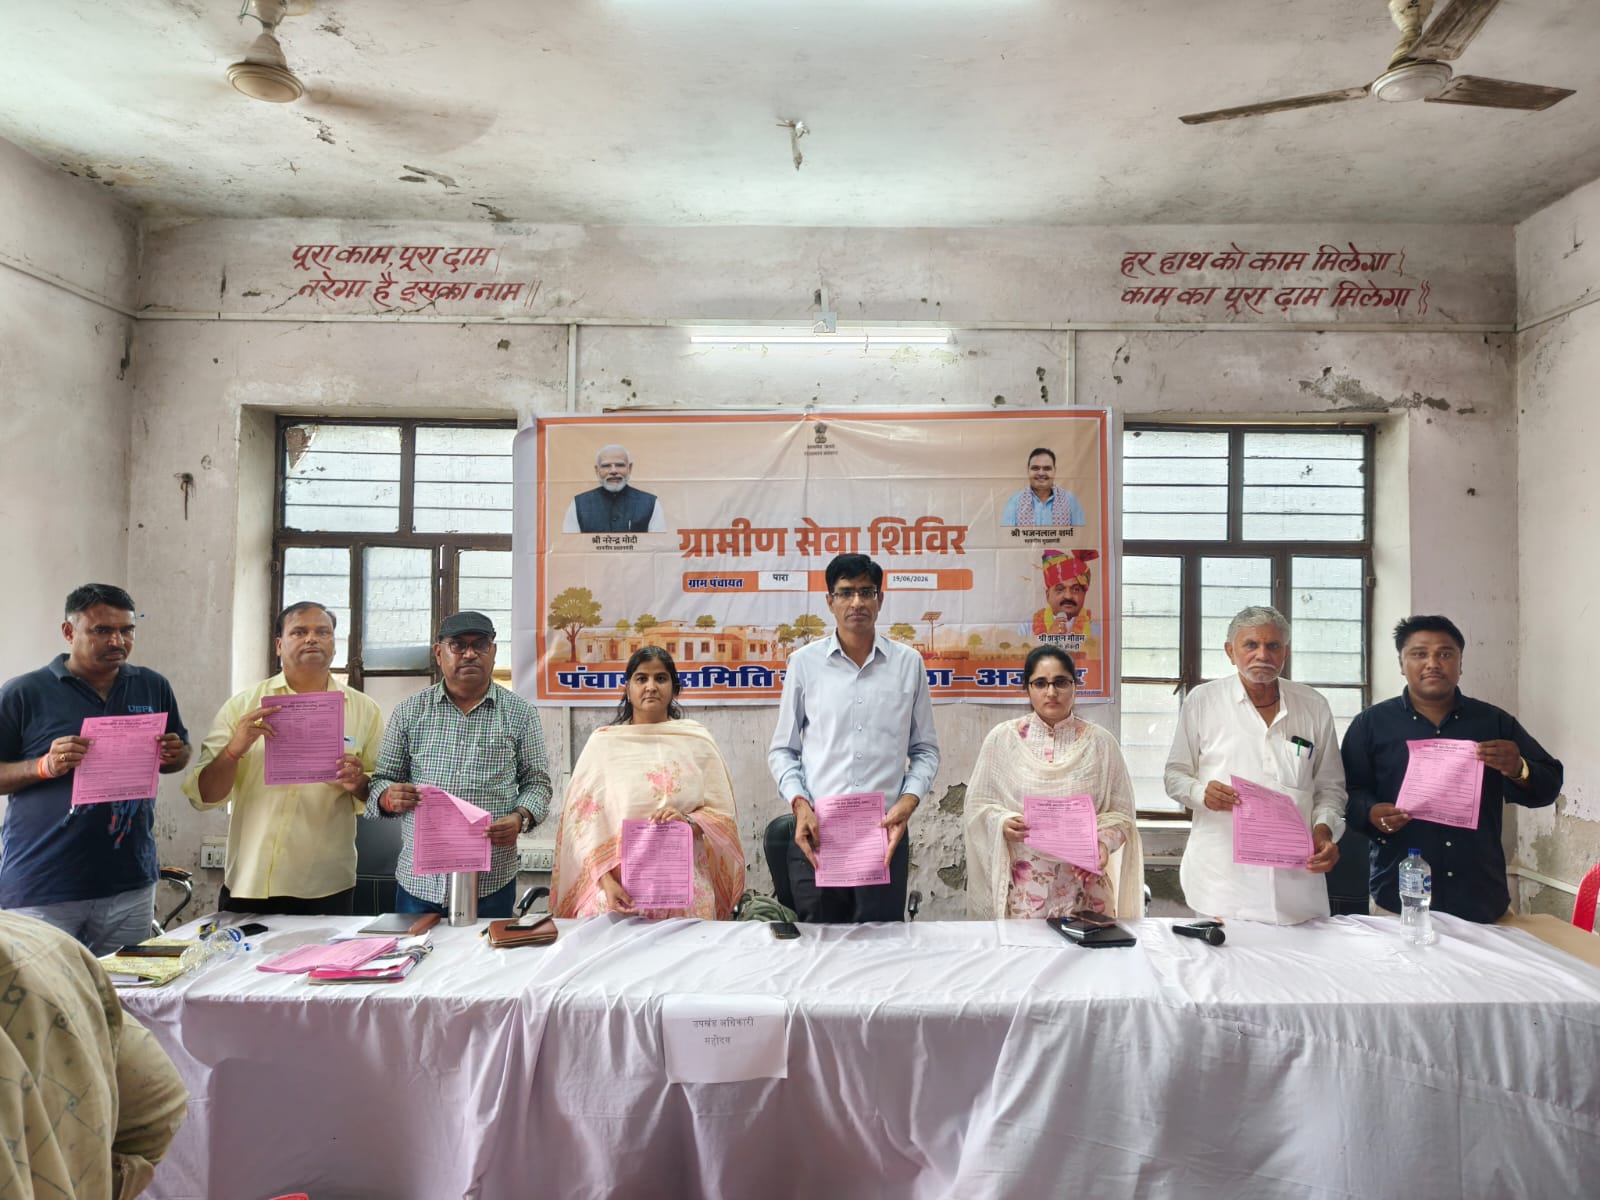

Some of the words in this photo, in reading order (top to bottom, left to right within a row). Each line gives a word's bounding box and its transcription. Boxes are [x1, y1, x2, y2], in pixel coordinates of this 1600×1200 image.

[292, 245, 338, 270] पूरा
[399, 246, 445, 273] पूरा
[1121, 251, 1156, 279] हर
[1159, 251, 1214, 278] हाथ
[1210, 242, 1249, 272] को
[1249, 252, 1310, 272] काम
[373, 271, 399, 308] है
[400, 280, 477, 305] इसका
[1121, 286, 1178, 306] काम
[1176, 286, 1221, 306] का
[1225, 286, 1272, 315] पूरा
[622, 534, 638, 544] मोदी
[677, 517, 788, 558] ग्रामीण
[794, 517, 861, 557] सेवा
[867, 516, 968, 556] शिविर
[1011, 528, 1020, 537] श्री
[1022, 529, 1057, 537] भजनलाल
[1058, 527, 1074, 537] शर्मा
[688, 578, 708, 588] ग्राम
[709, 576, 744, 588] पंचायत
[677, 665, 776, 688] समिति
